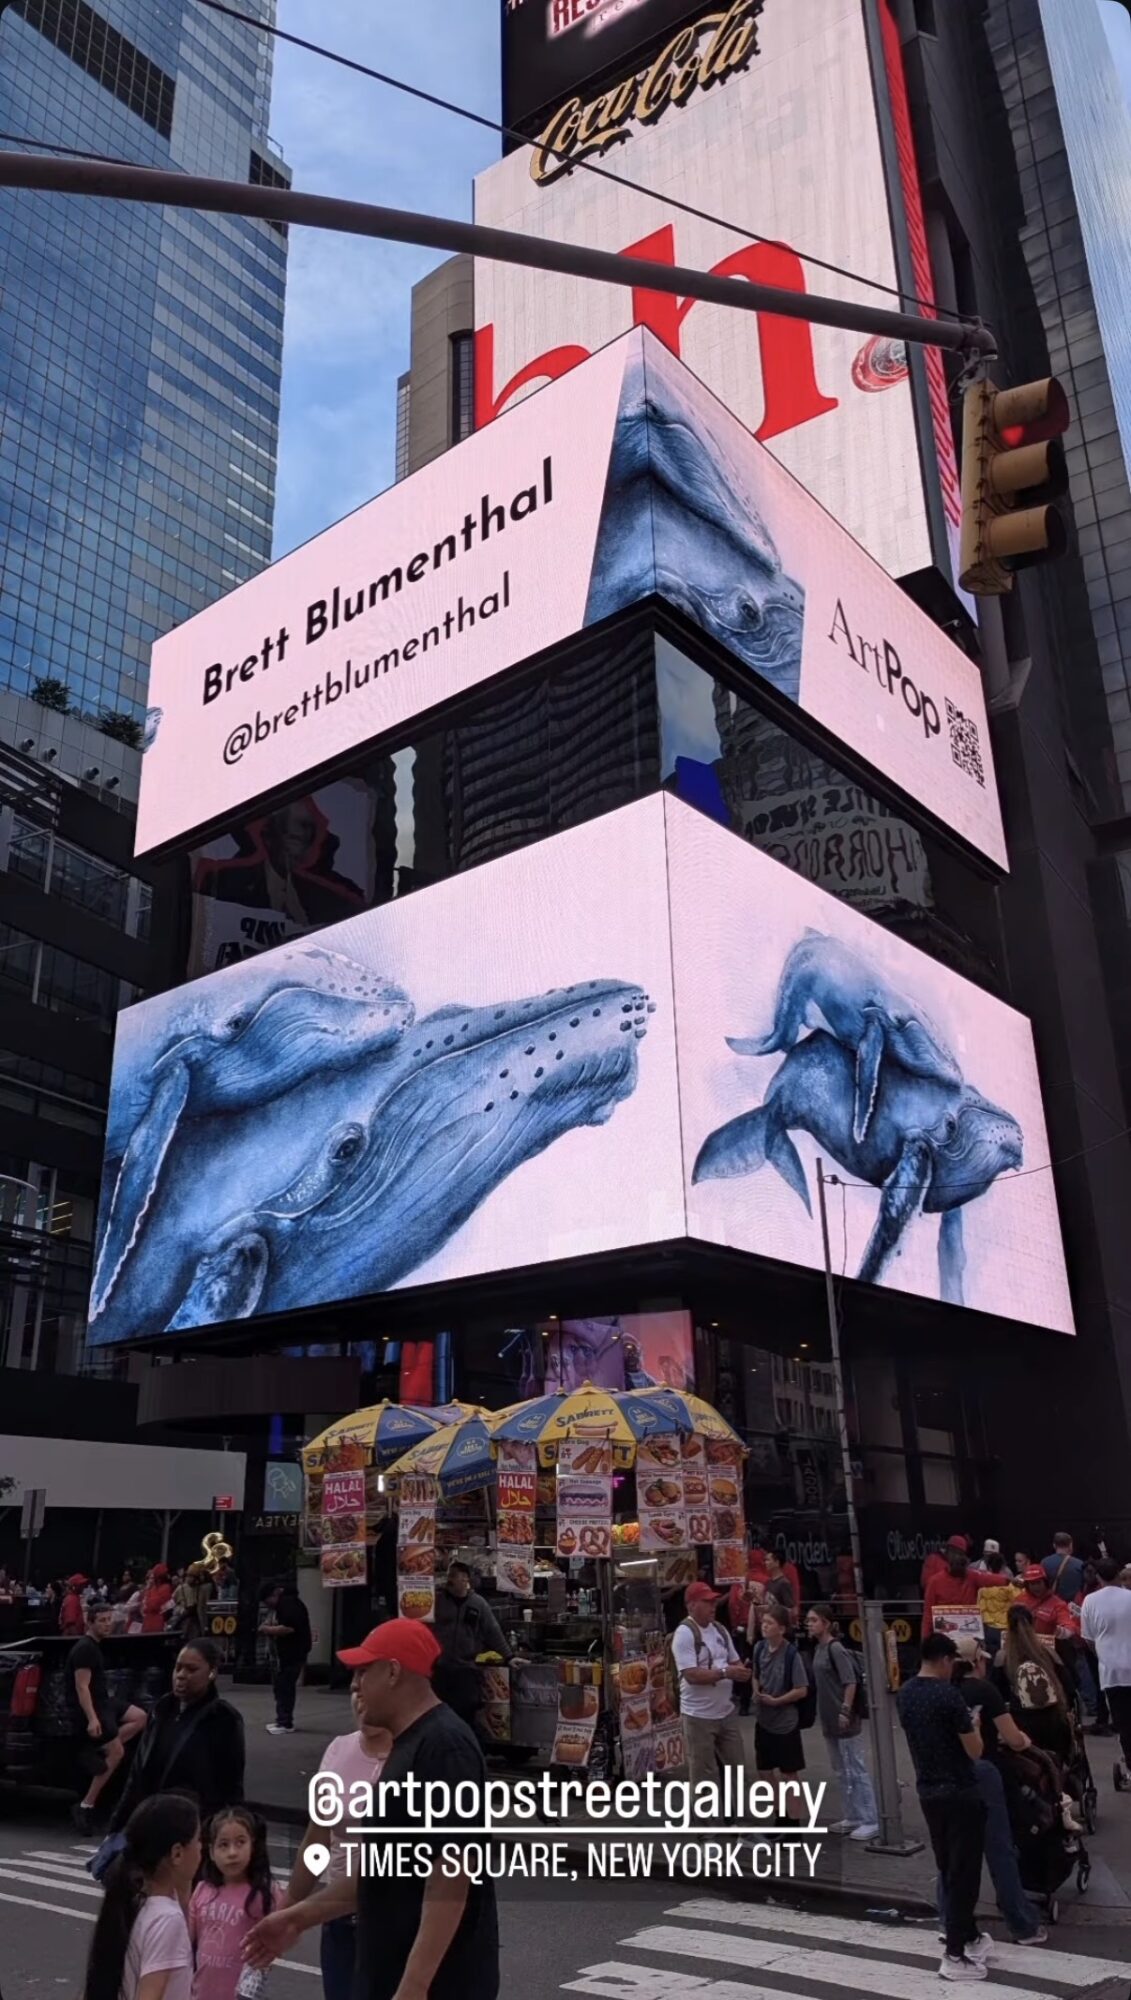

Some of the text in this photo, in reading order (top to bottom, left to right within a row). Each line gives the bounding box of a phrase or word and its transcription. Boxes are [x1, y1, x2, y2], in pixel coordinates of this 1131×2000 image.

[530, 0, 757, 182] Coca-Cola
[203, 456, 553, 705] Brett Blumenthal
[222, 571, 511, 765] @brettblumenthal
[827, 597, 941, 738] ArtPop
[325, 1480, 362, 1495] HALAL
[499, 1474, 534, 1490] HALAL
